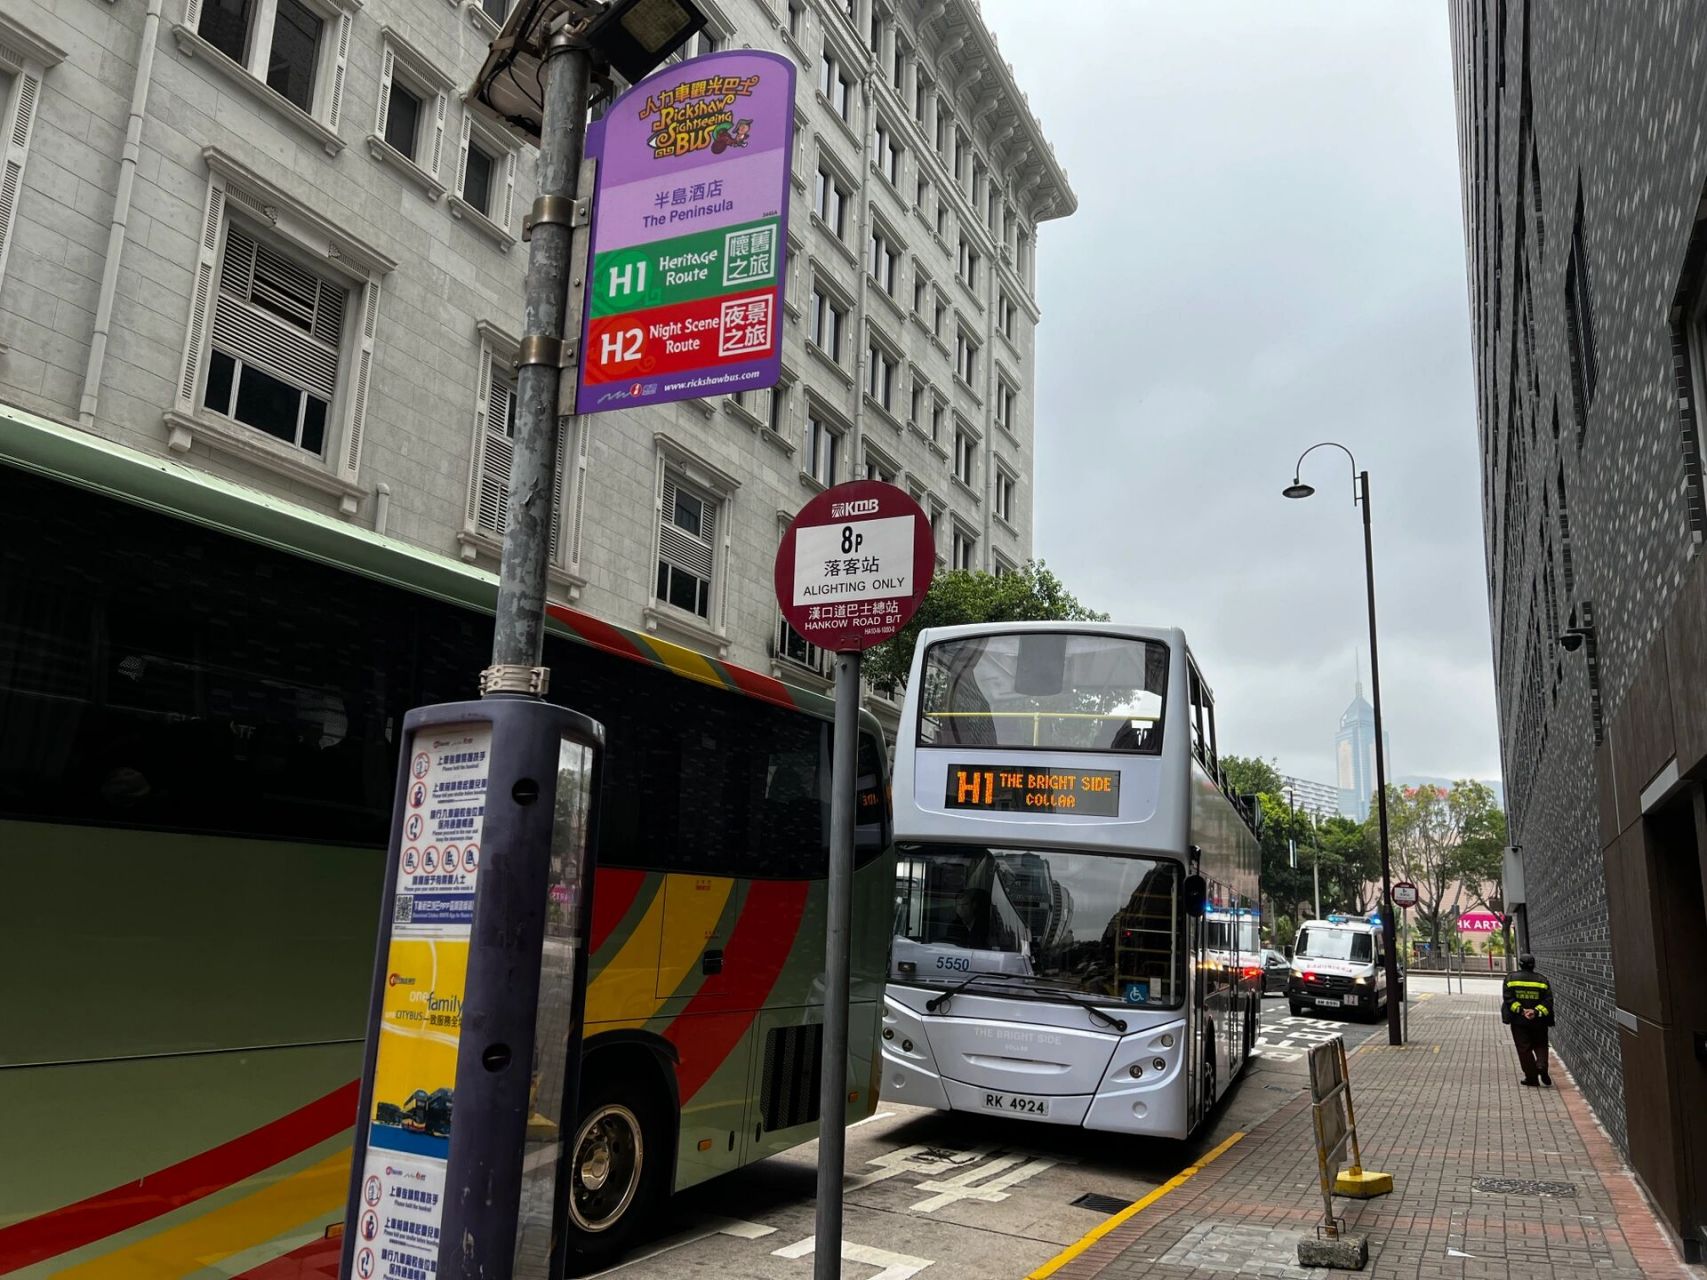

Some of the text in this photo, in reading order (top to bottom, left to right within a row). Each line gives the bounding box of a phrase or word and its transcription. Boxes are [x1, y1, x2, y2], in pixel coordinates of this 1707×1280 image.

[639, 75, 760, 120] 人力車觀光巴士
[653, 95, 735, 131] Rickshaw
[657, 112, 733, 146] Sightseeing
[675, 125, 714, 157] BUS
[654, 180, 723, 209] 半島酒店
[643, 200, 734, 229] The Peninsula
[659, 249, 718, 271] Heritage
[729, 254, 769, 279] 之旅
[608, 261, 647, 298] H1
[666, 268, 708, 286] Route
[725, 301, 767, 327] 夜景
[649, 316, 720, 340] Night Scene
[723, 324, 766, 350] 之旅
[600, 328, 644, 365] H2
[666, 339, 700, 354] Route
[664, 370, 760, 392] www.rickshawbus.com
[845, 499, 879, 516] KMB
[824, 556, 880, 577] 落客站
[803, 577, 905, 597] ALIGHTING ONLY
[805, 614, 902, 630] HANKOW ROAD B/T
[808, 600, 899, 620] 漢口道巴士總站
[957, 771, 1112, 805] H1 THE BRIGHT SIDE
[936, 956, 970, 971] 5550
[427, 991, 463, 1017] family
[986, 1094, 1045, 1114] RK 4924
